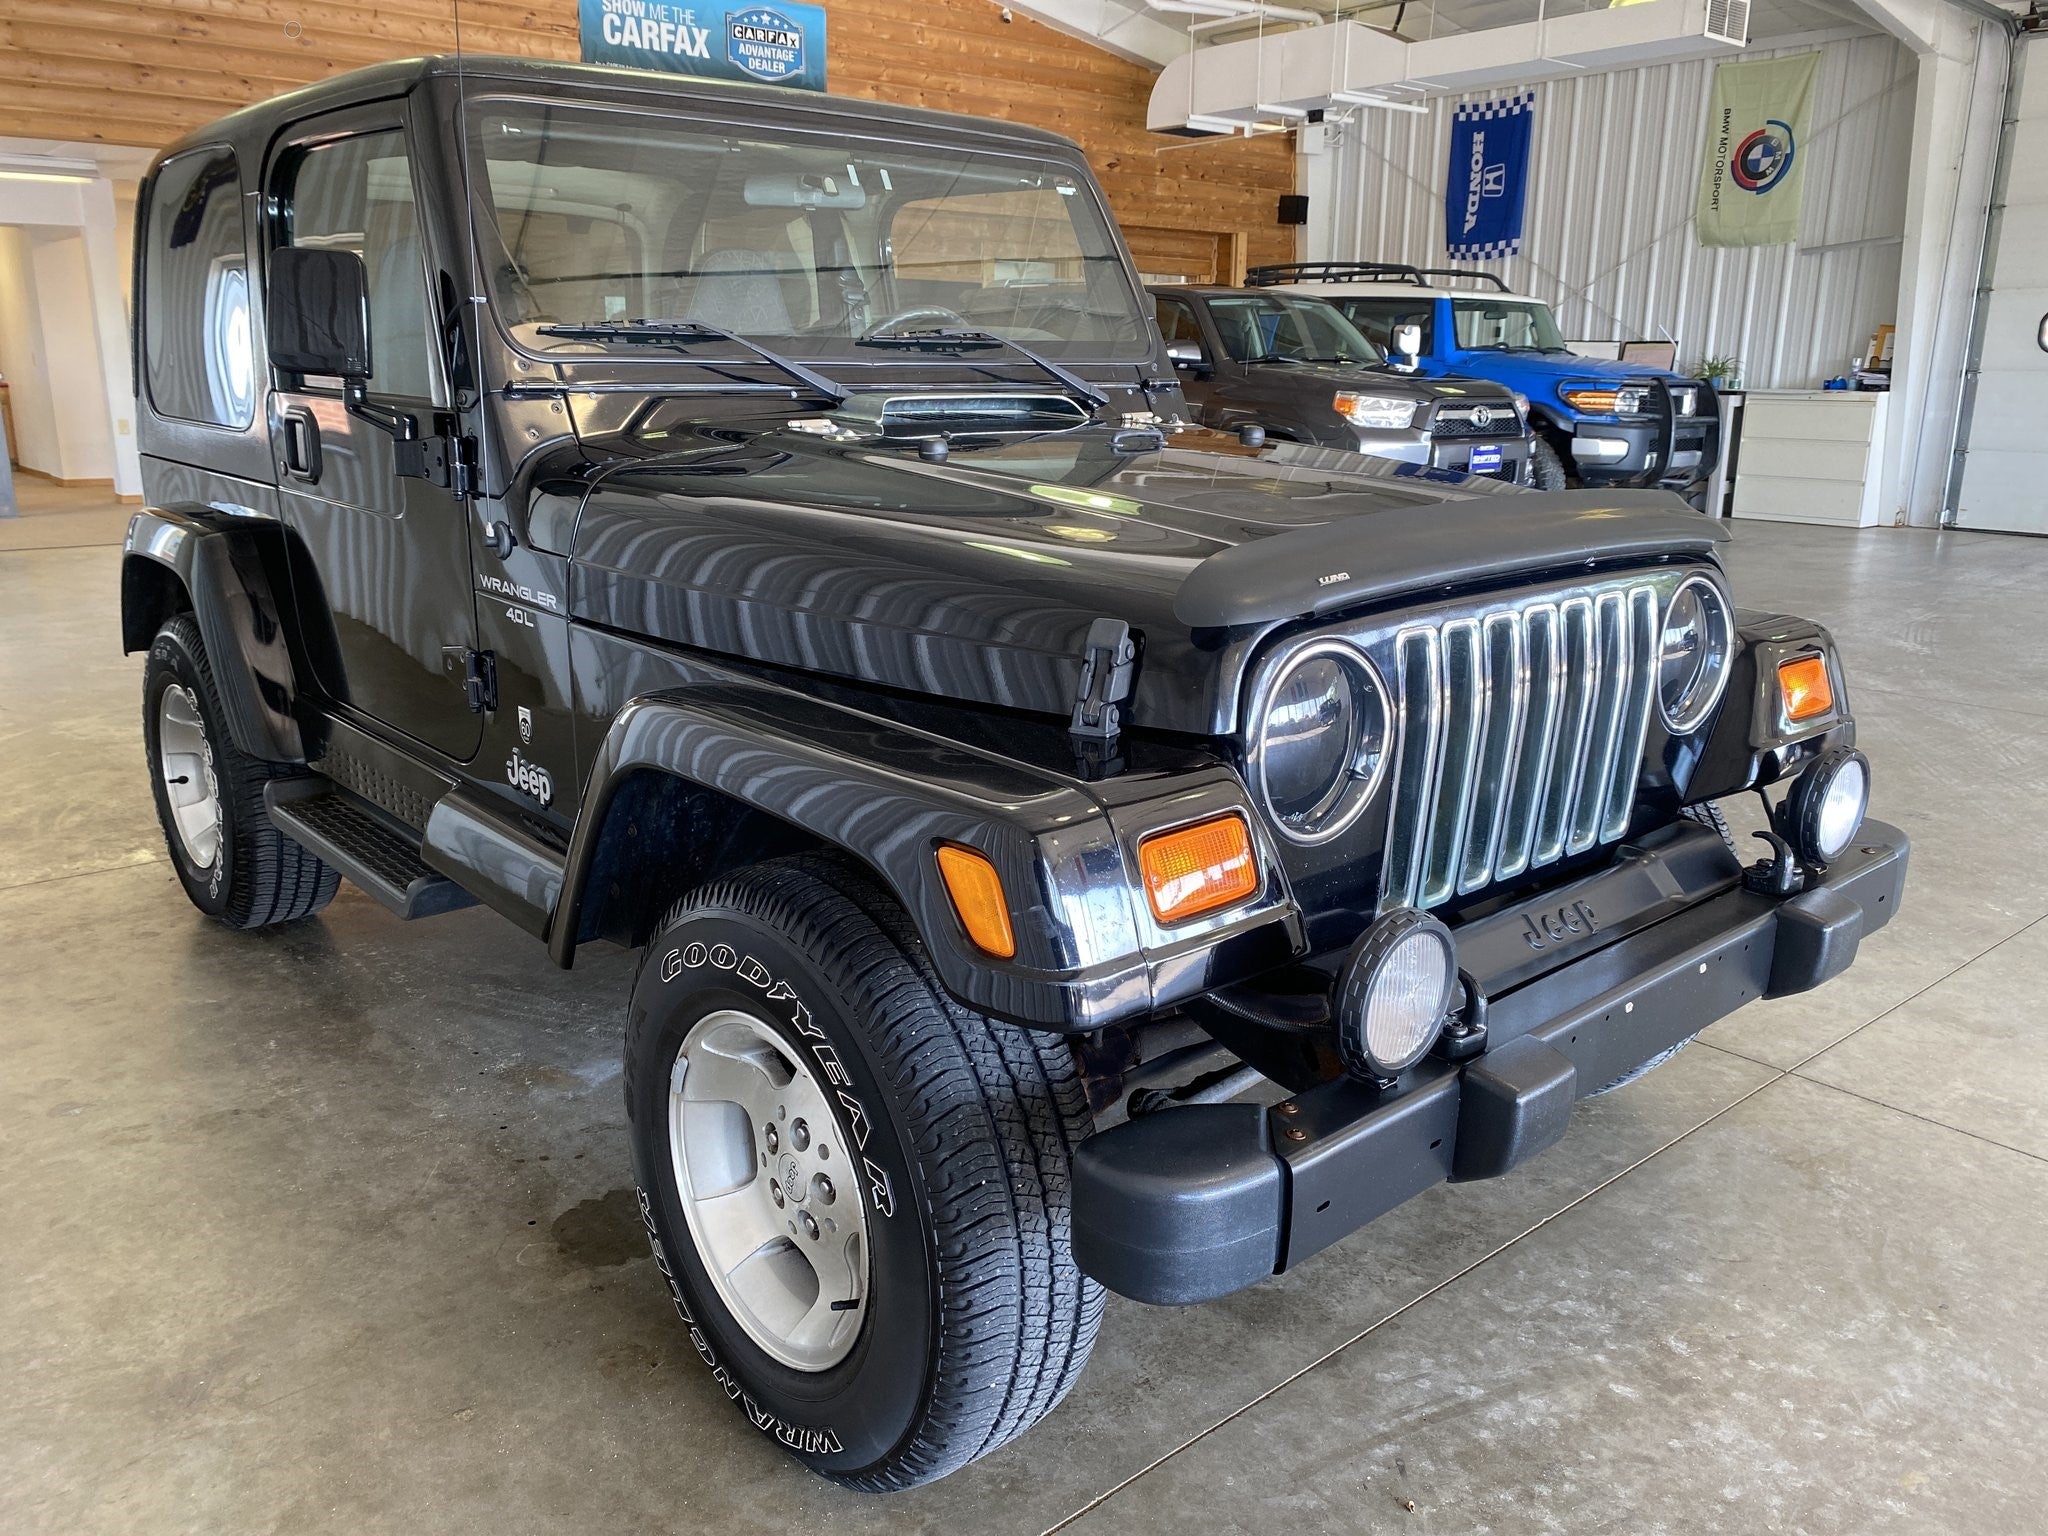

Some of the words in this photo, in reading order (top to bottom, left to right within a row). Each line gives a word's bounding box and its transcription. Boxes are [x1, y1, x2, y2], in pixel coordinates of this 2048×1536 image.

[602, 0, 645, 17] SHOW
[649, 3, 669, 22] ME
[672, 6, 695, 26] THE
[603, 13, 710, 59] CARFAX
[734, 25, 798, 48] CARFAX
[739, 43, 795, 62] ADVANTAGE
[748, 58, 785, 73] DEALER
[1723, 108, 1731, 135] BMW
[1463, 131, 1485, 234] HONDA
[1710, 137, 1729, 212] MOTORSPORT
[480, 573, 557, 609] WRANGLER
[506, 747, 551, 806] Jeep
[1521, 900, 1601, 951] Jeep
[661, 942, 897, 1217] GOODYEAR
[637, 1186, 845, 1453] WRANGLER
